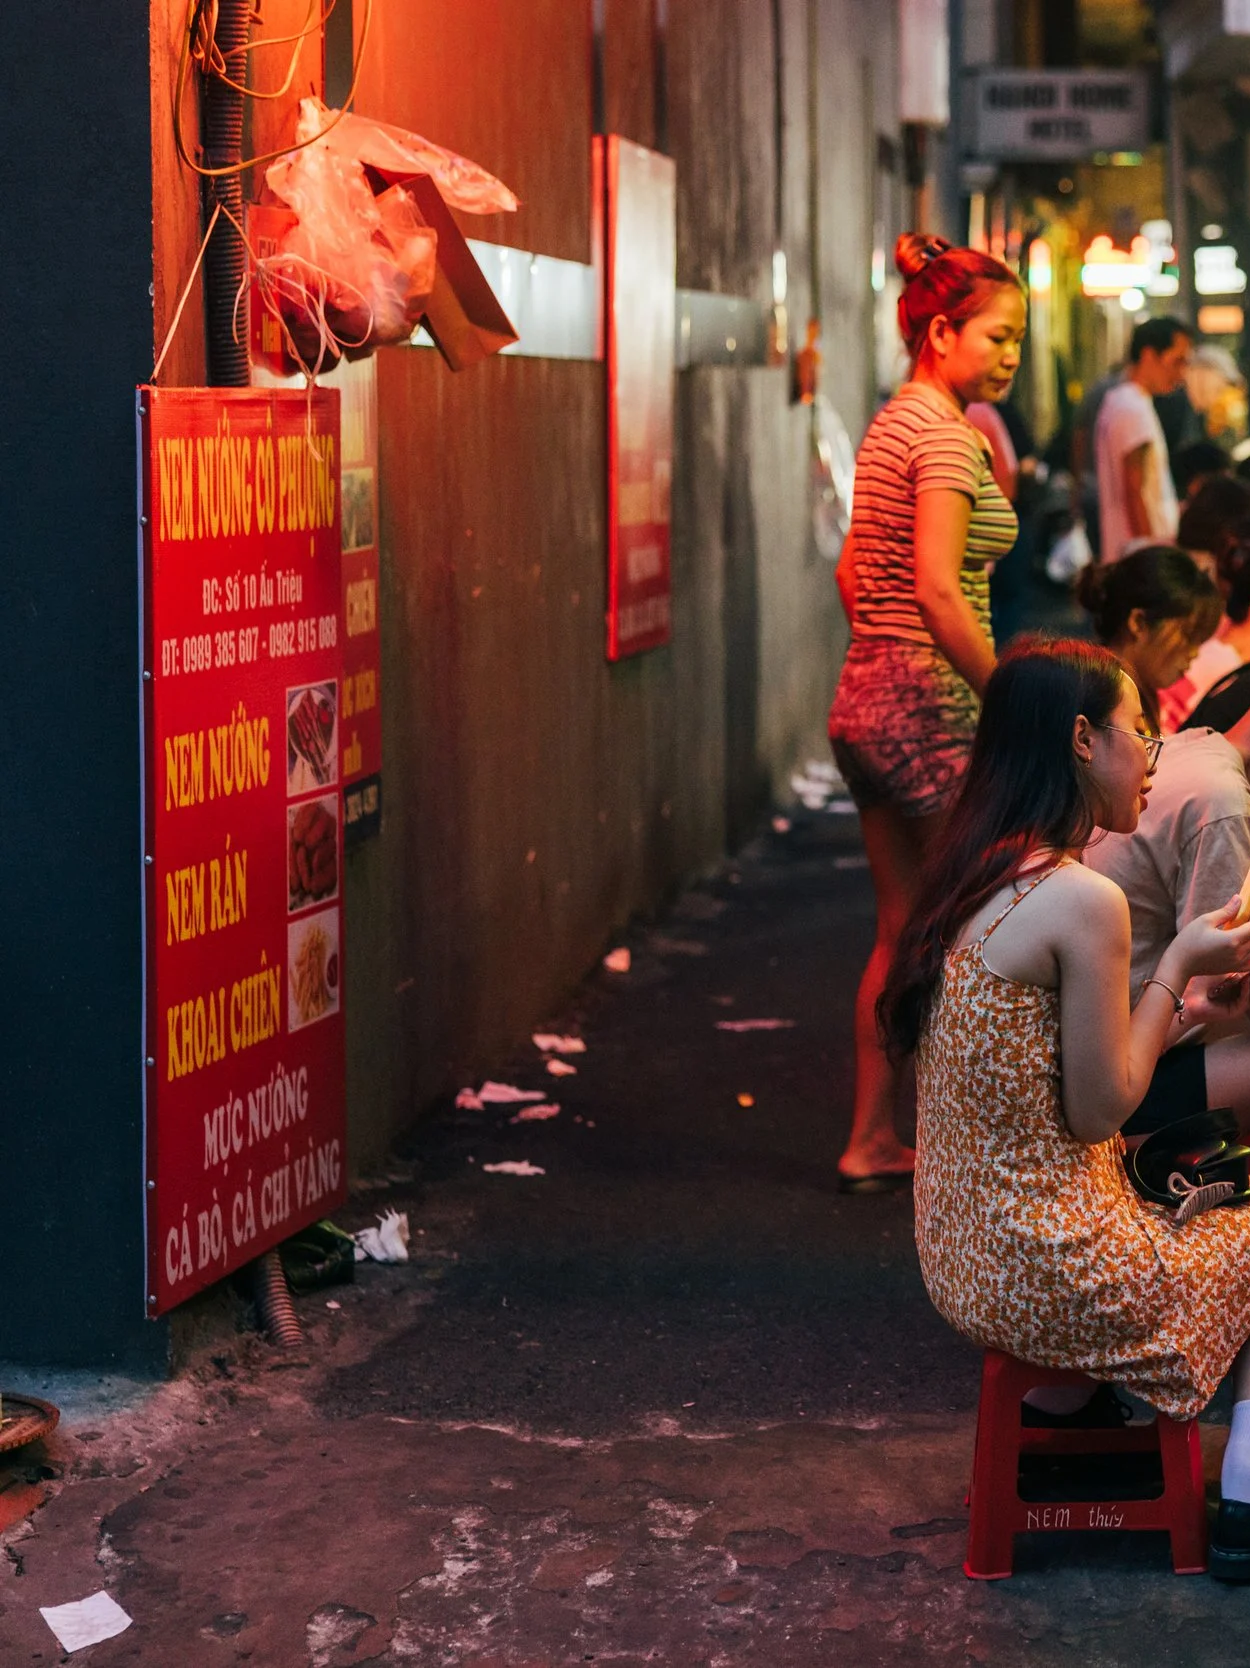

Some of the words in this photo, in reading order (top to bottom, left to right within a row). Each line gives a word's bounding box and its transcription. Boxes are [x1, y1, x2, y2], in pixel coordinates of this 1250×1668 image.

[158, 436, 194, 542] NEM
[202, 577, 222, 615] ĐC:
[225, 569, 240, 612] Số
[243, 574, 257, 610] 10
[259, 559, 273, 607] Ấu
[276, 567, 302, 611] Triệu
[162, 638, 180, 677] ĐT:
[183, 633, 211, 674] 0989
[214, 629, 235, 668] 385
[238, 625, 259, 664] 607
[269, 620, 295, 658] 0982
[297, 617, 316, 653] 915
[165, 730, 204, 811] NEM
[208, 700, 271, 800] NƯỚNG
[166, 861, 205, 946] NEM
[210, 832, 247, 931] RÁN
[167, 986, 226, 1082] KHOAI
[230, 949, 281, 1053] CHIÊN
[204, 1089, 243, 1177] MỰC
[248, 1061, 309, 1148] NƯỚNG
[165, 1202, 193, 1286] CÁ
[197, 1187, 228, 1268] BÒ,
[232, 1168, 256, 1247] CÁ
[261, 1143, 290, 1230] CHỈ
[294, 1136, 340, 1209] VÀNG
